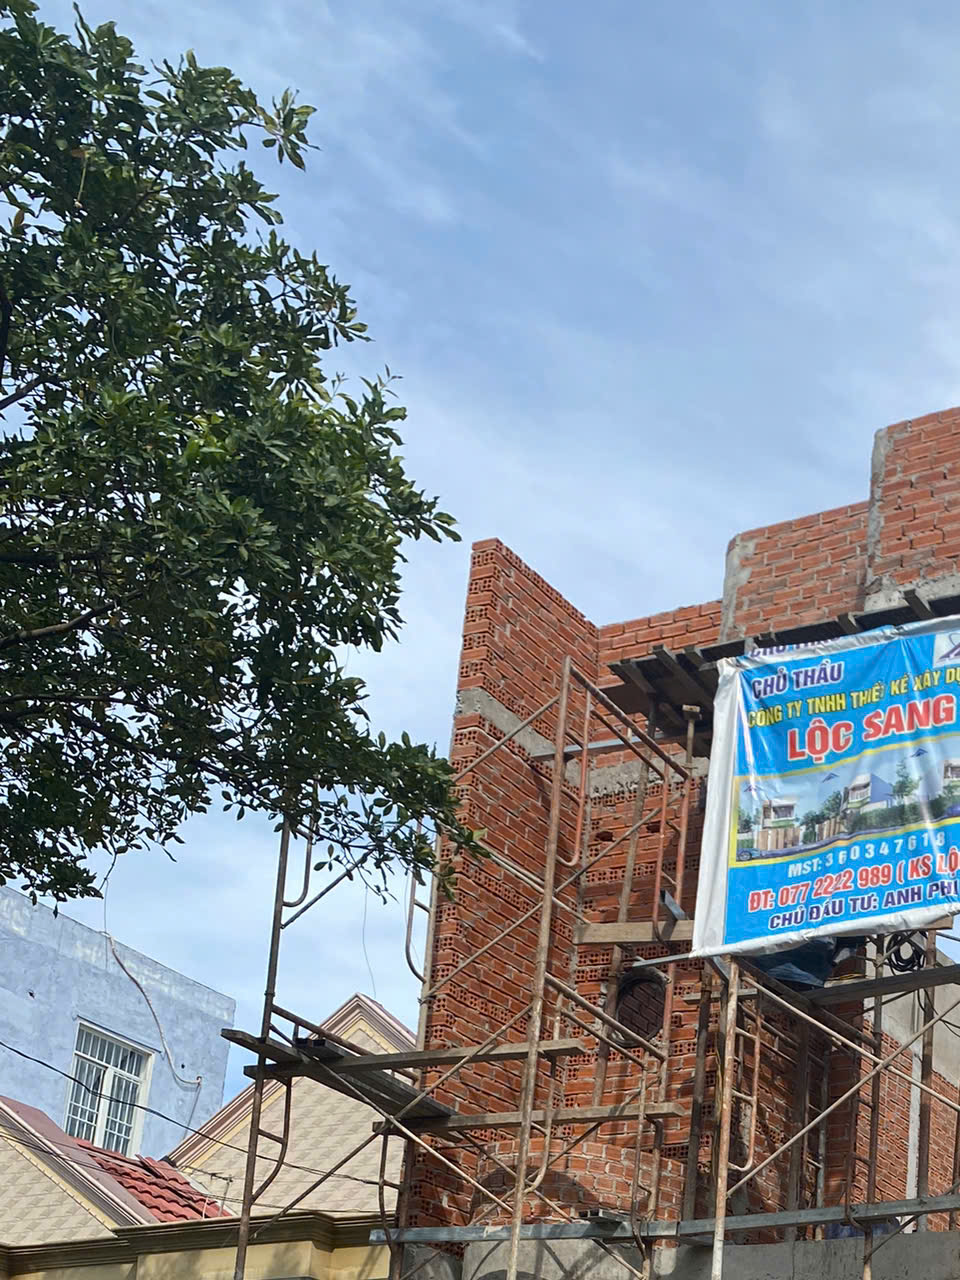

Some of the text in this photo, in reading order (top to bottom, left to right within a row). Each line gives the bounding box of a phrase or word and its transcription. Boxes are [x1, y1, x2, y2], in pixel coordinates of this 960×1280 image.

[752, 660, 844, 699] CHỦ THẦU
[786, 700, 803, 718] TY
[806, 693, 846, 715] TNHH
[914, 669, 941, 690] XÂY
[788, 694, 955, 762] LỘC SANG
[749, 889, 775, 911] ĐT:
[779, 882, 810, 906] 077
[859, 863, 892, 888] 989
[909, 855, 932, 879] KS
[788, 858, 822, 877] MST:
[769, 905, 805, 929] CHỦ
[849, 893, 877, 912] TƯ:
[884, 885, 922, 907] ANH
